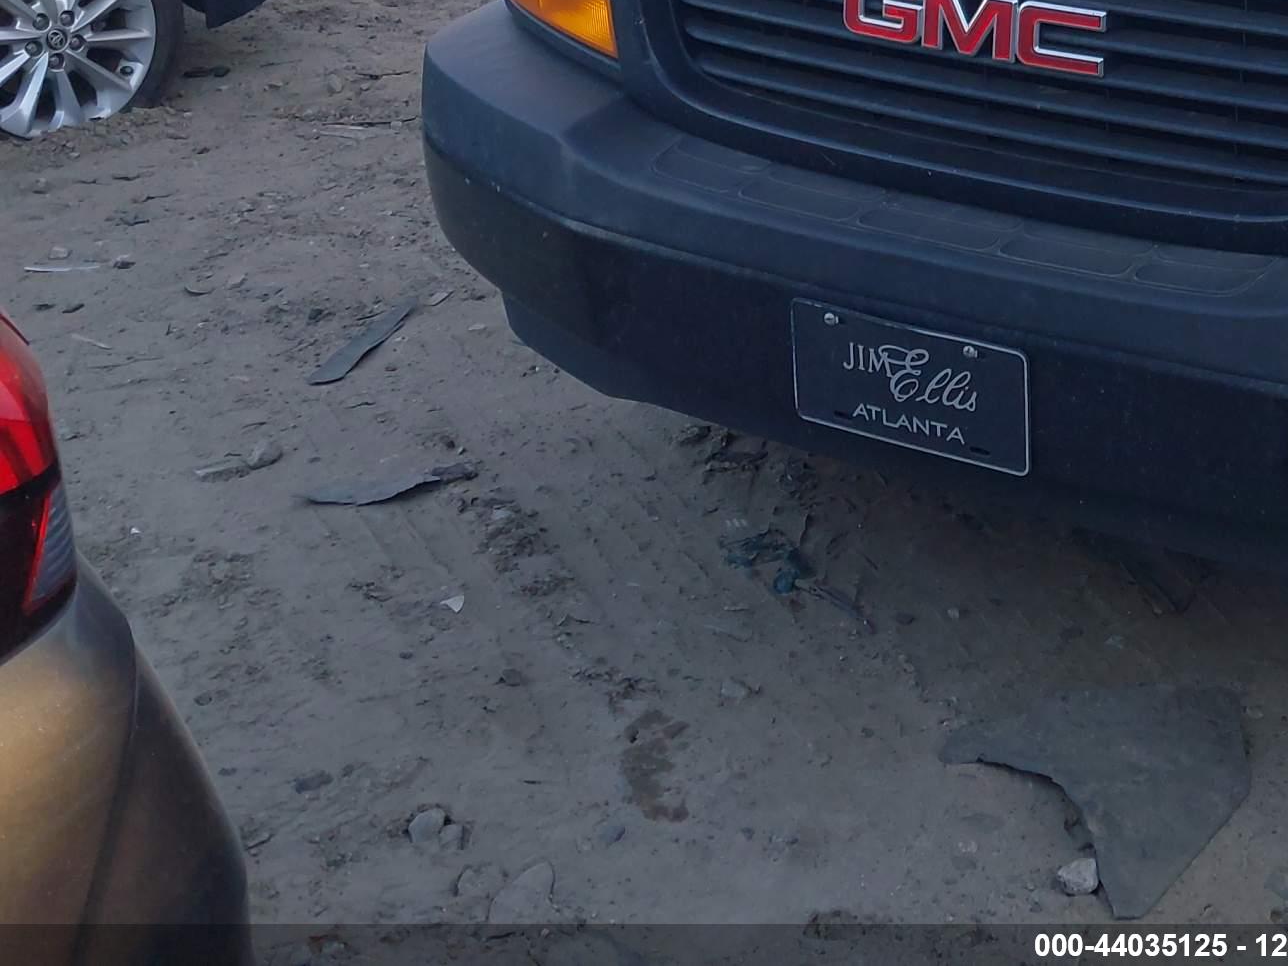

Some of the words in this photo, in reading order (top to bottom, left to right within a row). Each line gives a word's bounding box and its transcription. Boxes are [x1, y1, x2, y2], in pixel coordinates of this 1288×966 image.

[842, 342, 894, 378] JIM
[878, 345, 978, 412] Ellis
[852, 403, 965, 445] ATLANTA
